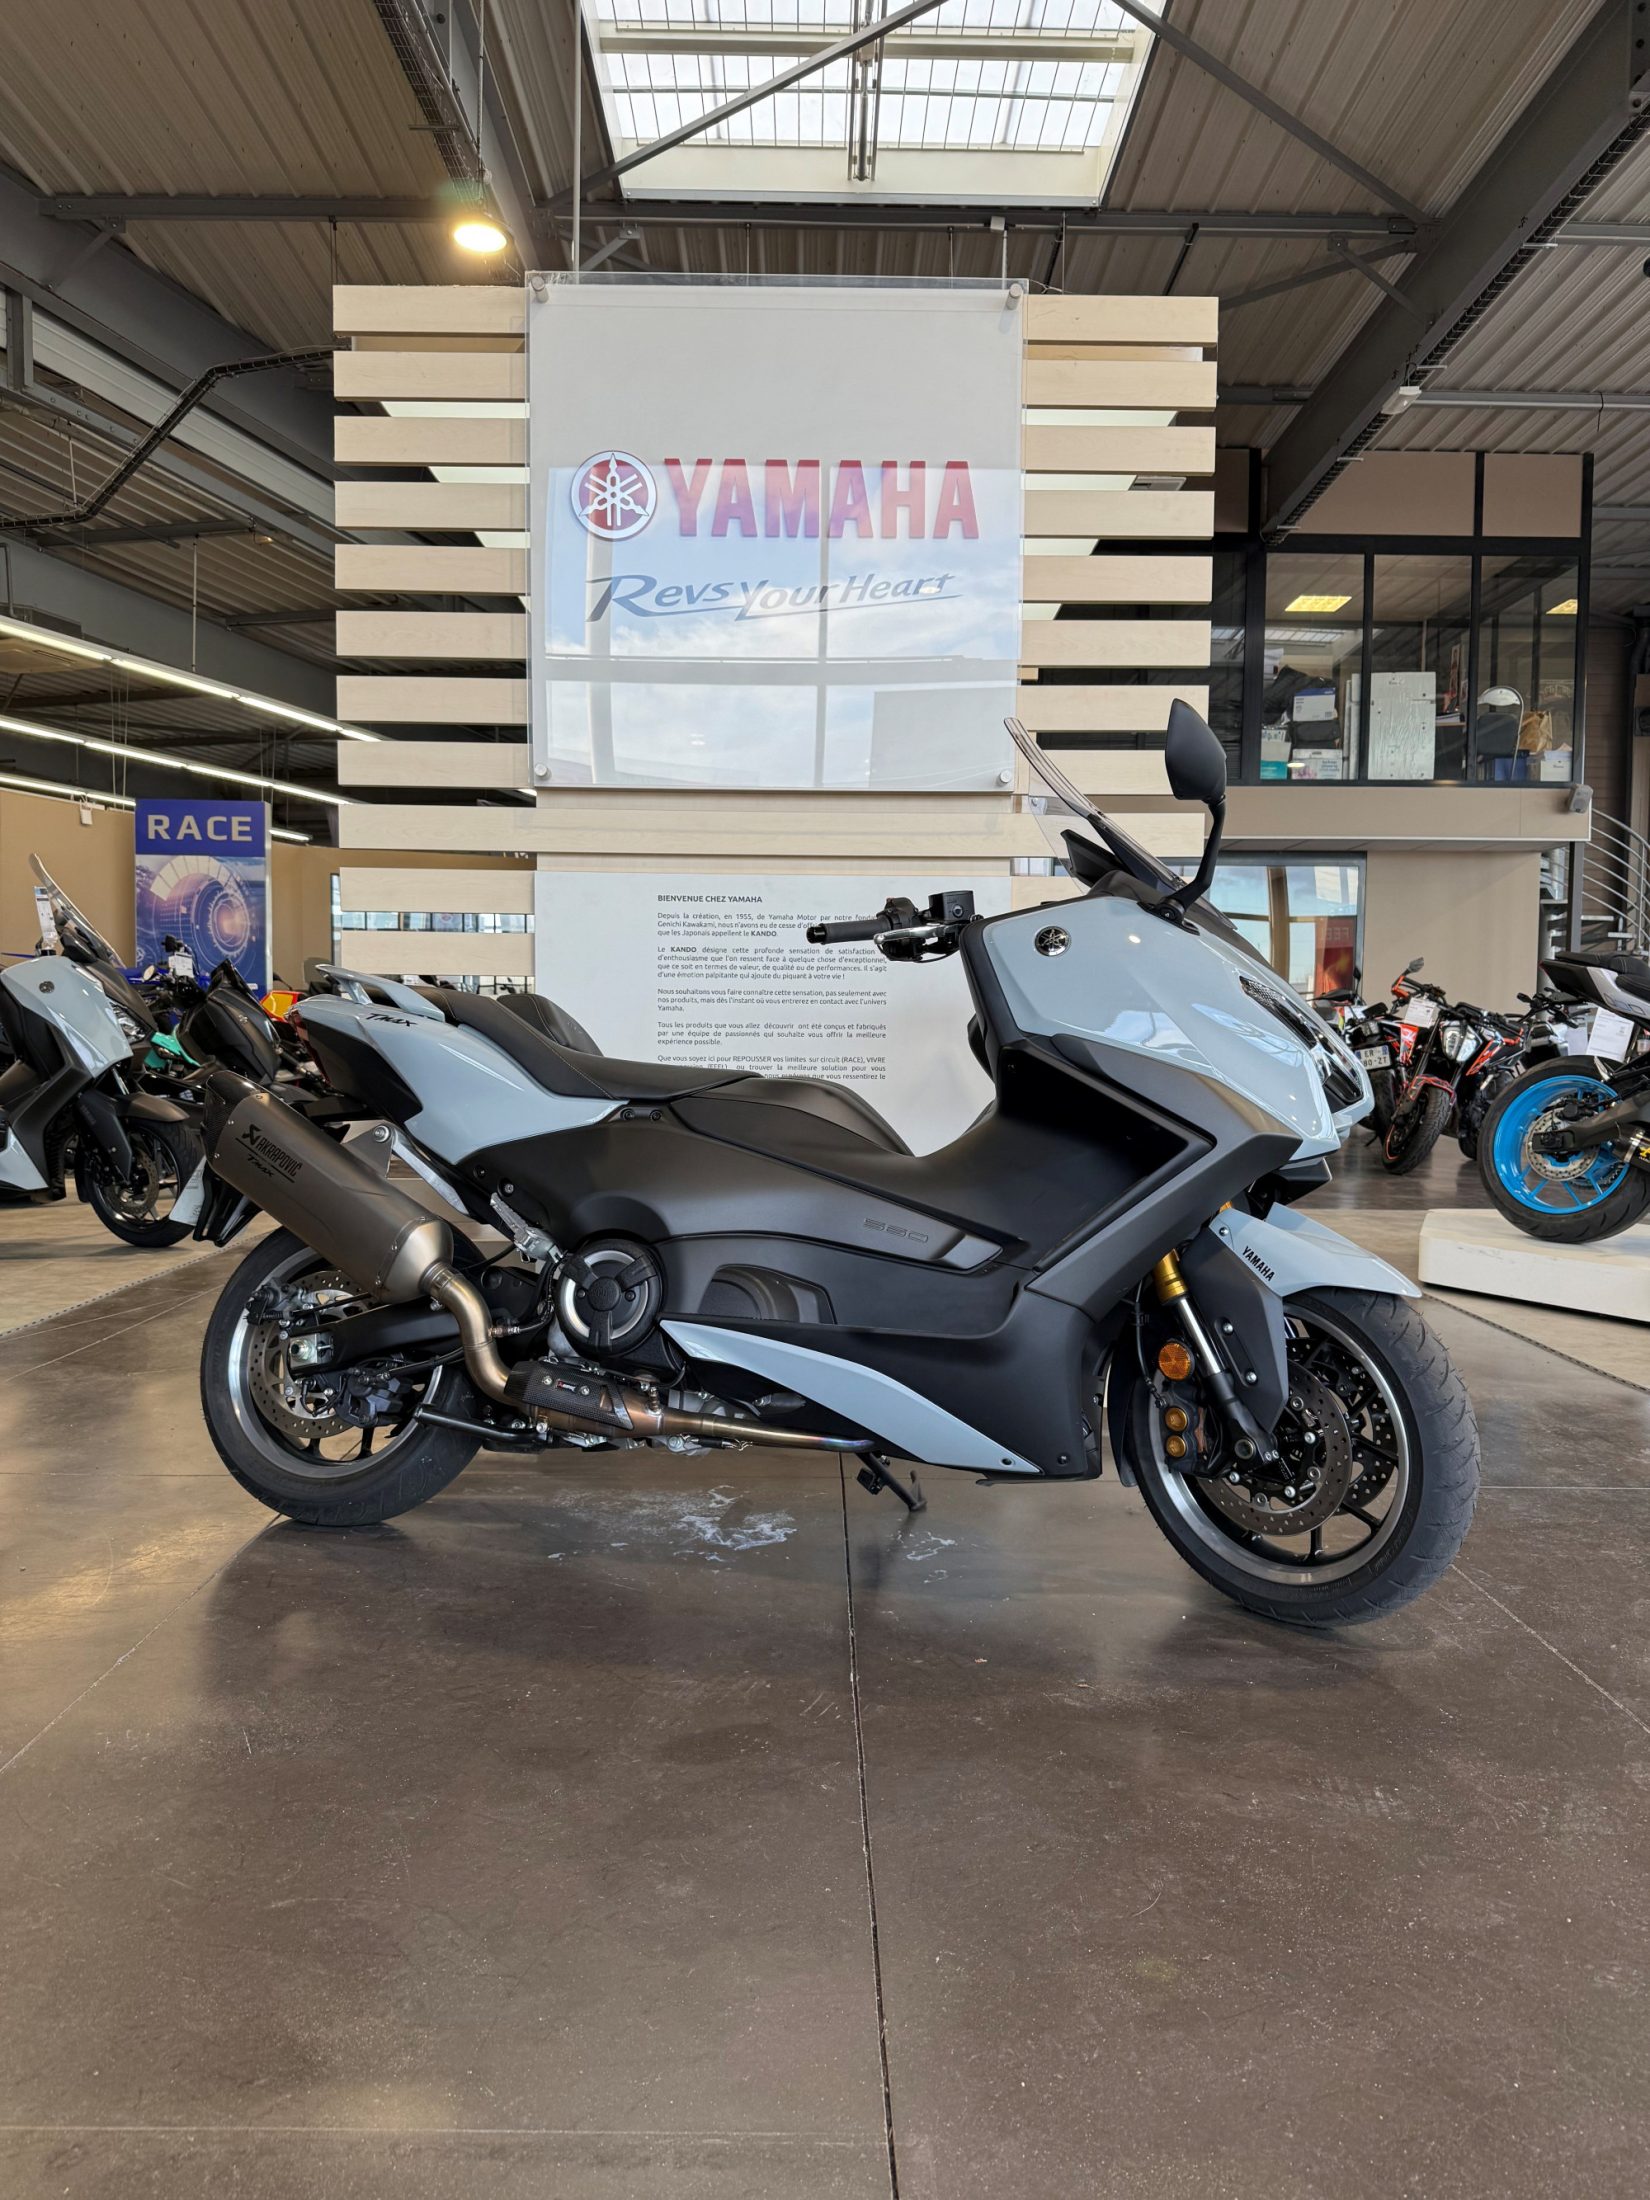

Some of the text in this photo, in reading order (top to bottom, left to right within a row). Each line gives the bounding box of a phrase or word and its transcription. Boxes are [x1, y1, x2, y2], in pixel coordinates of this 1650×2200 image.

[664, 457, 979, 540] YAMAHA
[585, 573, 957, 622] Revs Your Heart
[147, 814, 253, 842] RACE
[863, 1217, 929, 1243] 560
[1242, 1245, 1275, 1282] YAMAHA
